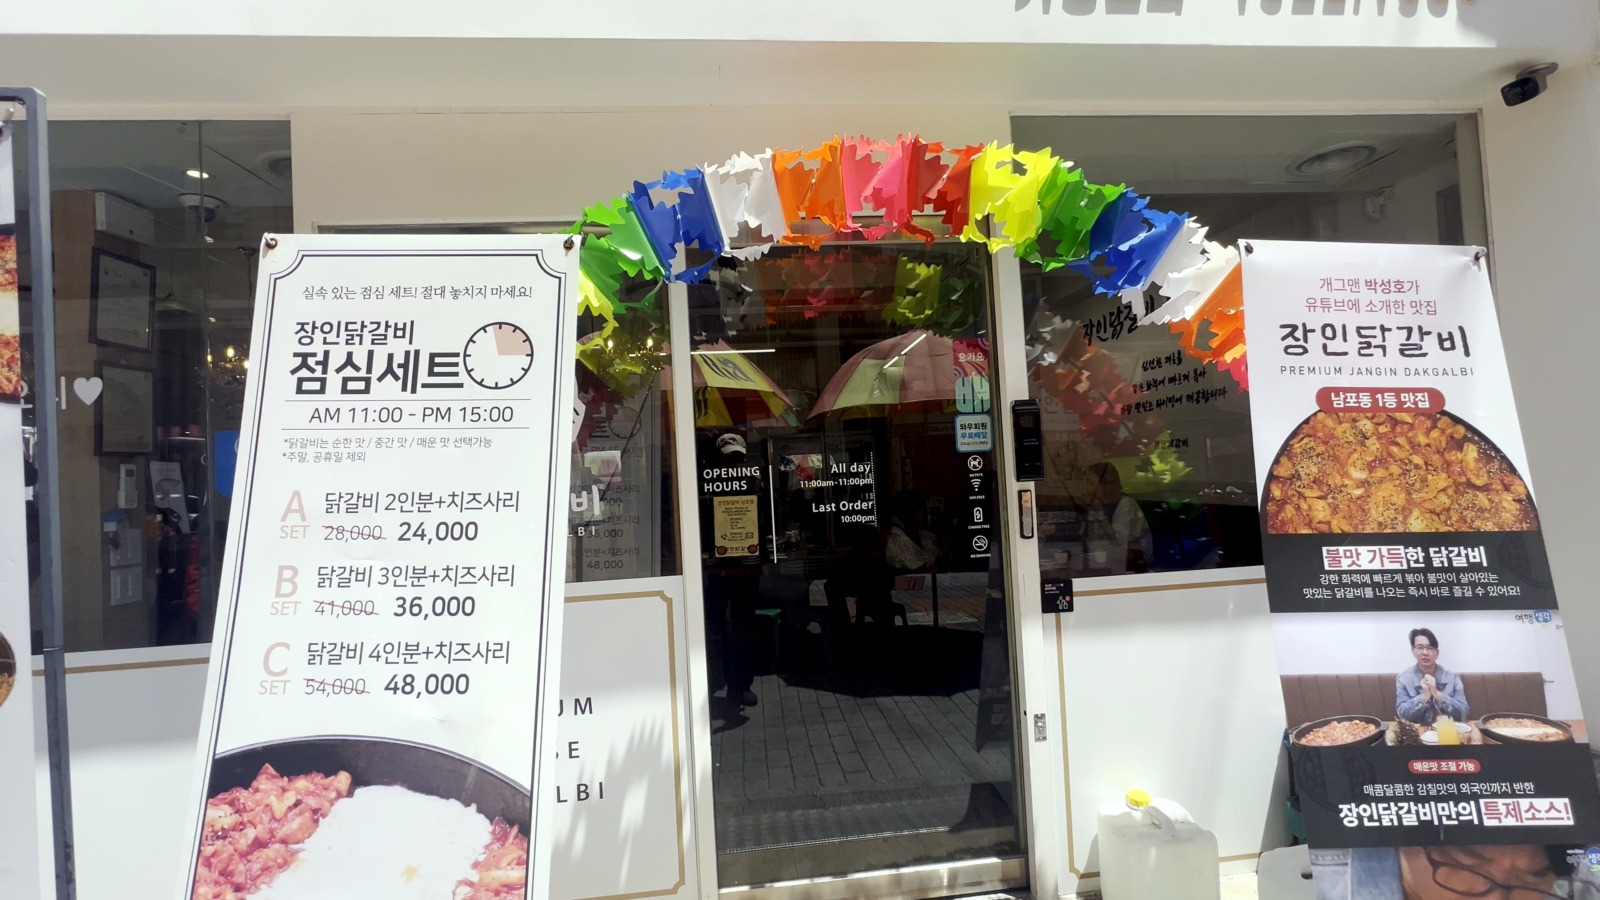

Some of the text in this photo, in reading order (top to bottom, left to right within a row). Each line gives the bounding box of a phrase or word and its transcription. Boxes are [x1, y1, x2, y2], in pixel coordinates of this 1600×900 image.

[303, 285, 532, 300] 실속 있는 점심 세트! 절대 놓치지 마세요!
[1319, 277, 1420, 295] 개그맨 박성호가
[1305, 297, 1437, 316] 유튜브에 소개한 맛집
[294, 320, 415, 346] 장인닭갈비
[1279, 322, 1471, 358] 장인닭갈비
[958, 352, 985, 362] 요기요
[289, 349, 464, 395] 점심세트
[1280, 365, 1474, 377] PREMIUM JANGIN DAKGALBI
[1331, 392, 1430, 409] 남포동 1등 맛집
[309, 407, 341, 423] AM
[348, 407, 403, 423] 11:00
[422, 406, 451, 423] PM
[458, 406, 514, 423] 15:00
[332, 438, 352, 448] 순한
[355, 437, 365, 448] 맛
[374, 437, 394, 448] 중간
[397, 437, 407, 448] 맛
[417, 437, 437, 448] 매운
[440, 437, 450, 448] 맛
[452, 436, 493, 448] 선택가능
[313, 452, 343, 463] 공휴일
[346, 451, 366, 462] 제외
[703, 466, 760, 479] OPENING
[831, 463, 871, 476] All day
[704, 480, 747, 493] HOURS
[280, 490, 307, 522] A
[325, 491, 520, 514] 닭갈비 2인분+치즈사리
[571, 484, 600, 515] 비
[812, 500, 874, 513] Last Order
[840, 515, 875, 524] 10:00pm
[279, 525, 310, 539] SET
[323, 521, 479, 544] 28,000 24,000
[568, 525, 595, 537] BI
[1325, 546, 1488, 569] 불맛 가득한 닭갈비
[275, 565, 299, 599] B
[317, 565, 515, 589] 닭갈비 3인분+치즈사리
[1319, 572, 1499, 585] 강한 화력에 빠르게 볶아 불맛이 살아있는
[1303, 585, 1521, 599] 맛있는 닭갈비를 나오는 즉시 바로 즐길 수 있어요!
[270, 602, 301, 616] SET
[314, 596, 475, 620] 41,000 36,000
[1515, 613, 1534, 624] 여행
[263, 642, 291, 677] C
[307, 641, 510, 666] 닭갈비 4인분+치즈사리
[258, 680, 291, 696] SET
[304, 674, 470, 698] 54,000 48,000
[556, 741, 579, 759] E
[1414, 761, 1475, 772] 매운맛 조절 가능
[556, 782, 603, 803] LBI
[1363, 782, 1535, 796] 매콤달콤한 감칠맛의 외국인까지 반한
[1338, 800, 1571, 827] 장인닭갈비만의 특제소스!
